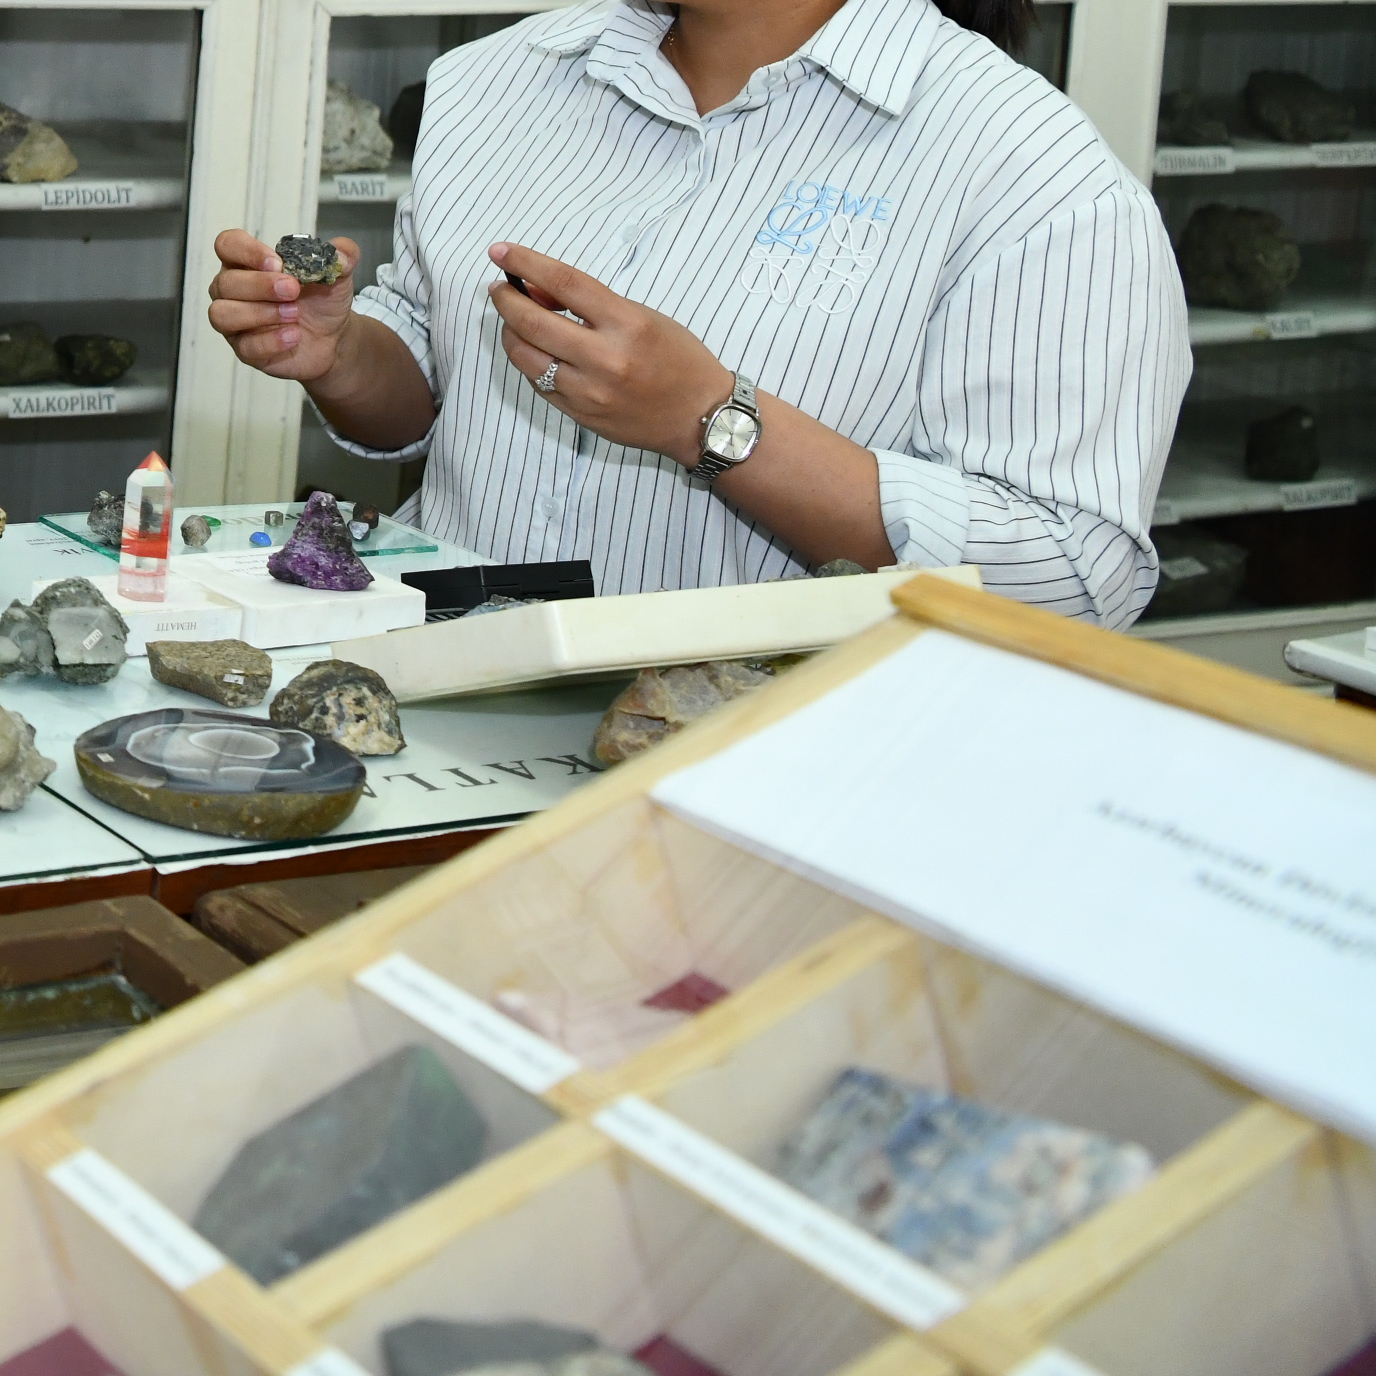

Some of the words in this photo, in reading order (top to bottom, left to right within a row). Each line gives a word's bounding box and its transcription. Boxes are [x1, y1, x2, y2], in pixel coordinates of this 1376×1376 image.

[43, 185, 133, 207] LEPİDOLİT
[337, 179, 386, 198] BARİT
[782, 179, 894, 222] LOEWE
[11, 391, 116, 416] XALKOPİRİT
[153, 620, 198, 634] HEMATİT
